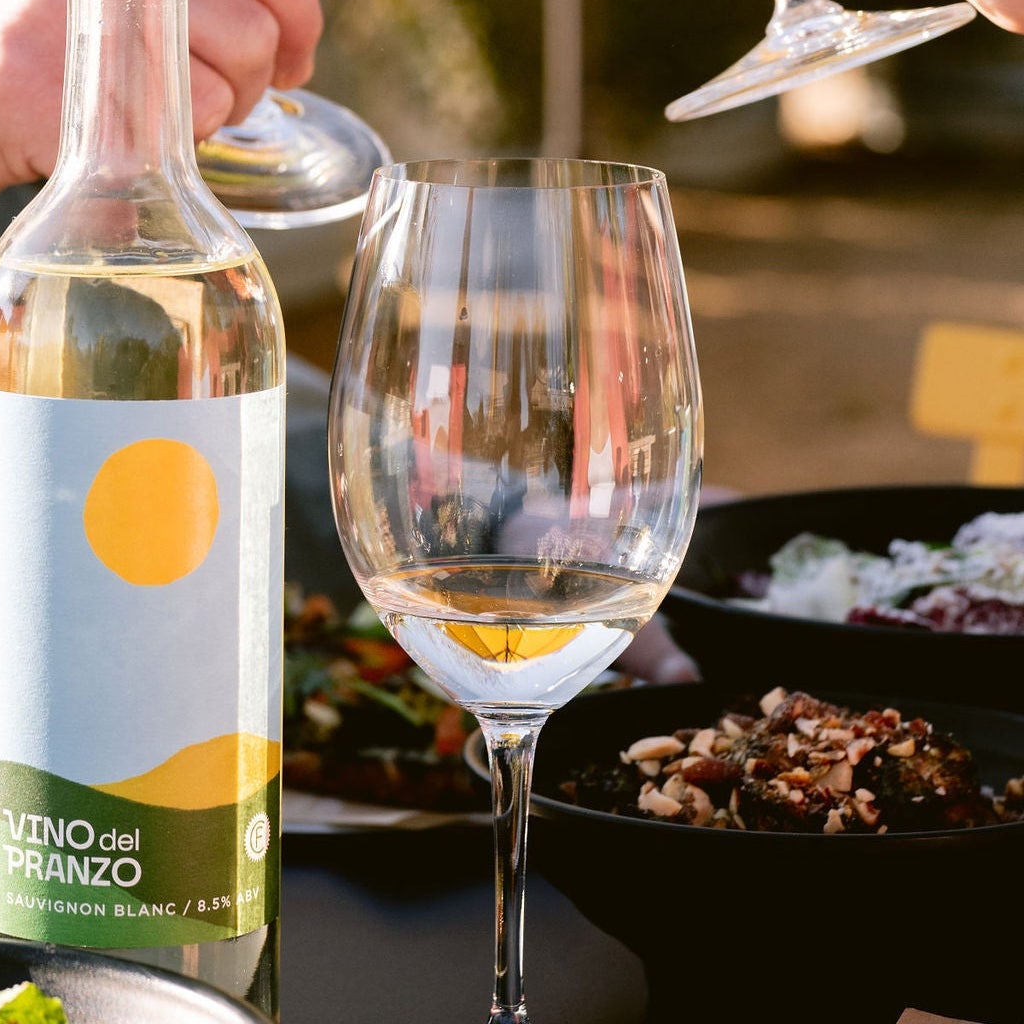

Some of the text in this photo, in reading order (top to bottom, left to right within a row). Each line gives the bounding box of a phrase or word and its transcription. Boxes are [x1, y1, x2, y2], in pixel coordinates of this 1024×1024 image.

[2, 808, 140, 851] VINO del
[2, 844, 142, 888] PRANZO
[6, 885, 260, 917] SAUVIGNON BLANC / 8.5% ABV
